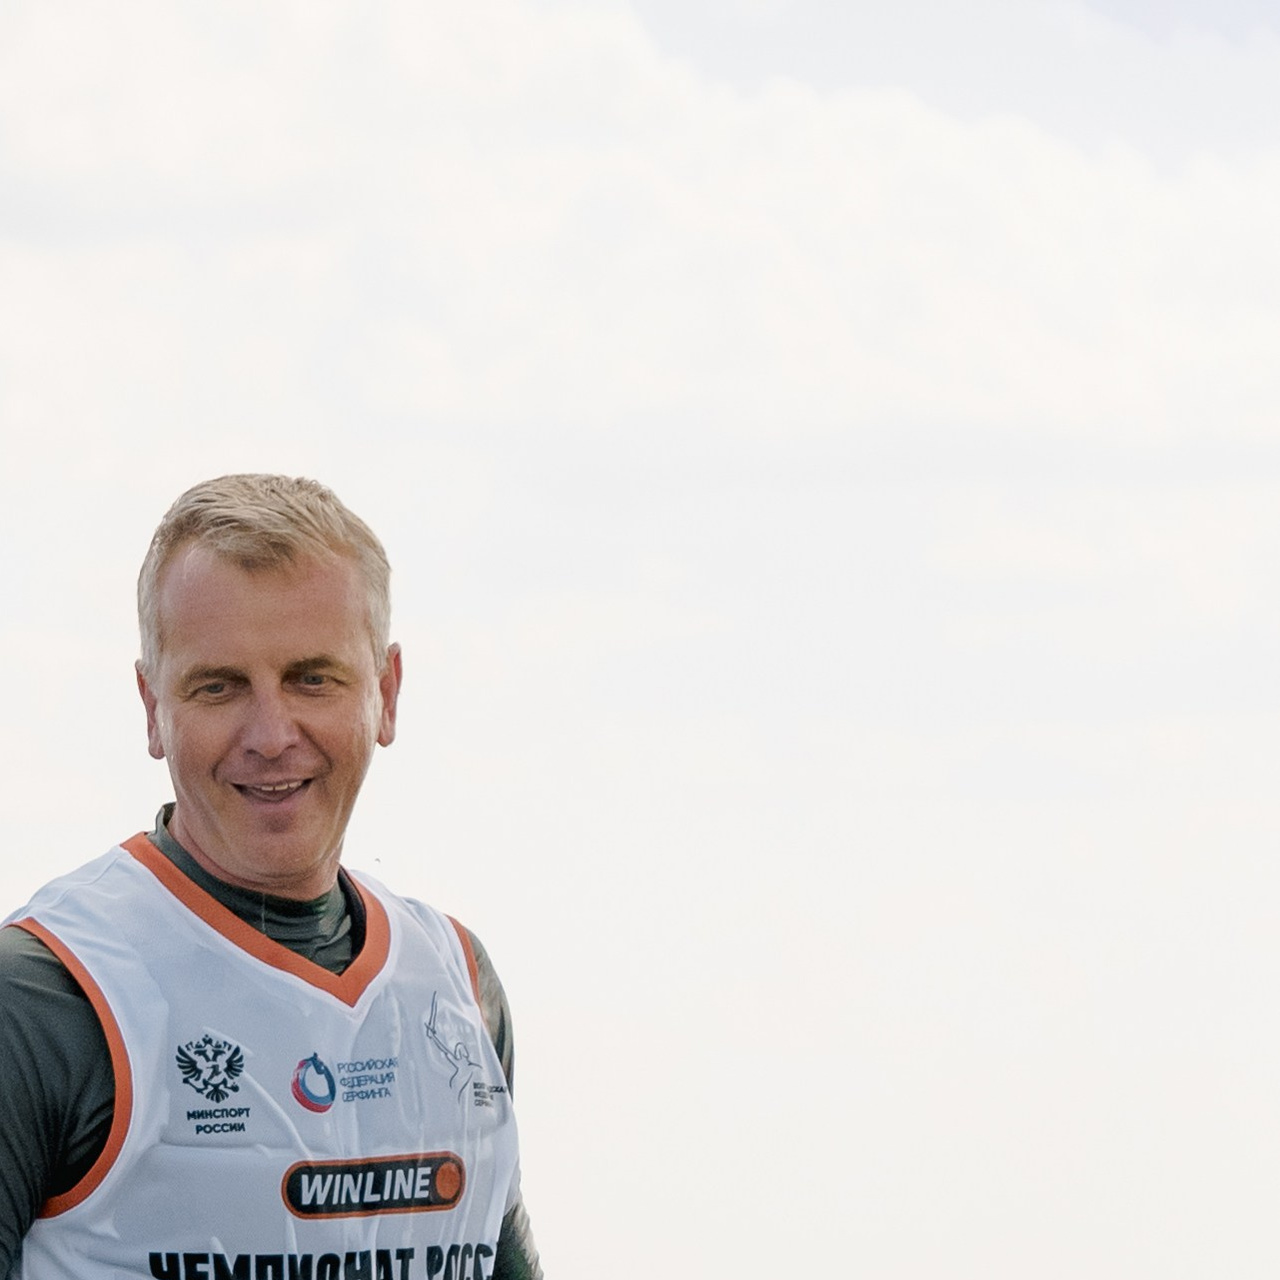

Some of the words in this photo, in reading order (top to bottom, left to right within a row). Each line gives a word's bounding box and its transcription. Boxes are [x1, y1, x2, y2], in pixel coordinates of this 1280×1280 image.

[342, 1086, 392, 1103] СЕРФИНГА
[186, 1107, 251, 1121] МИНСПОРТ
[195, 1122, 246, 1135] РОССИИ
[300, 1166, 432, 1206] WINLINE
